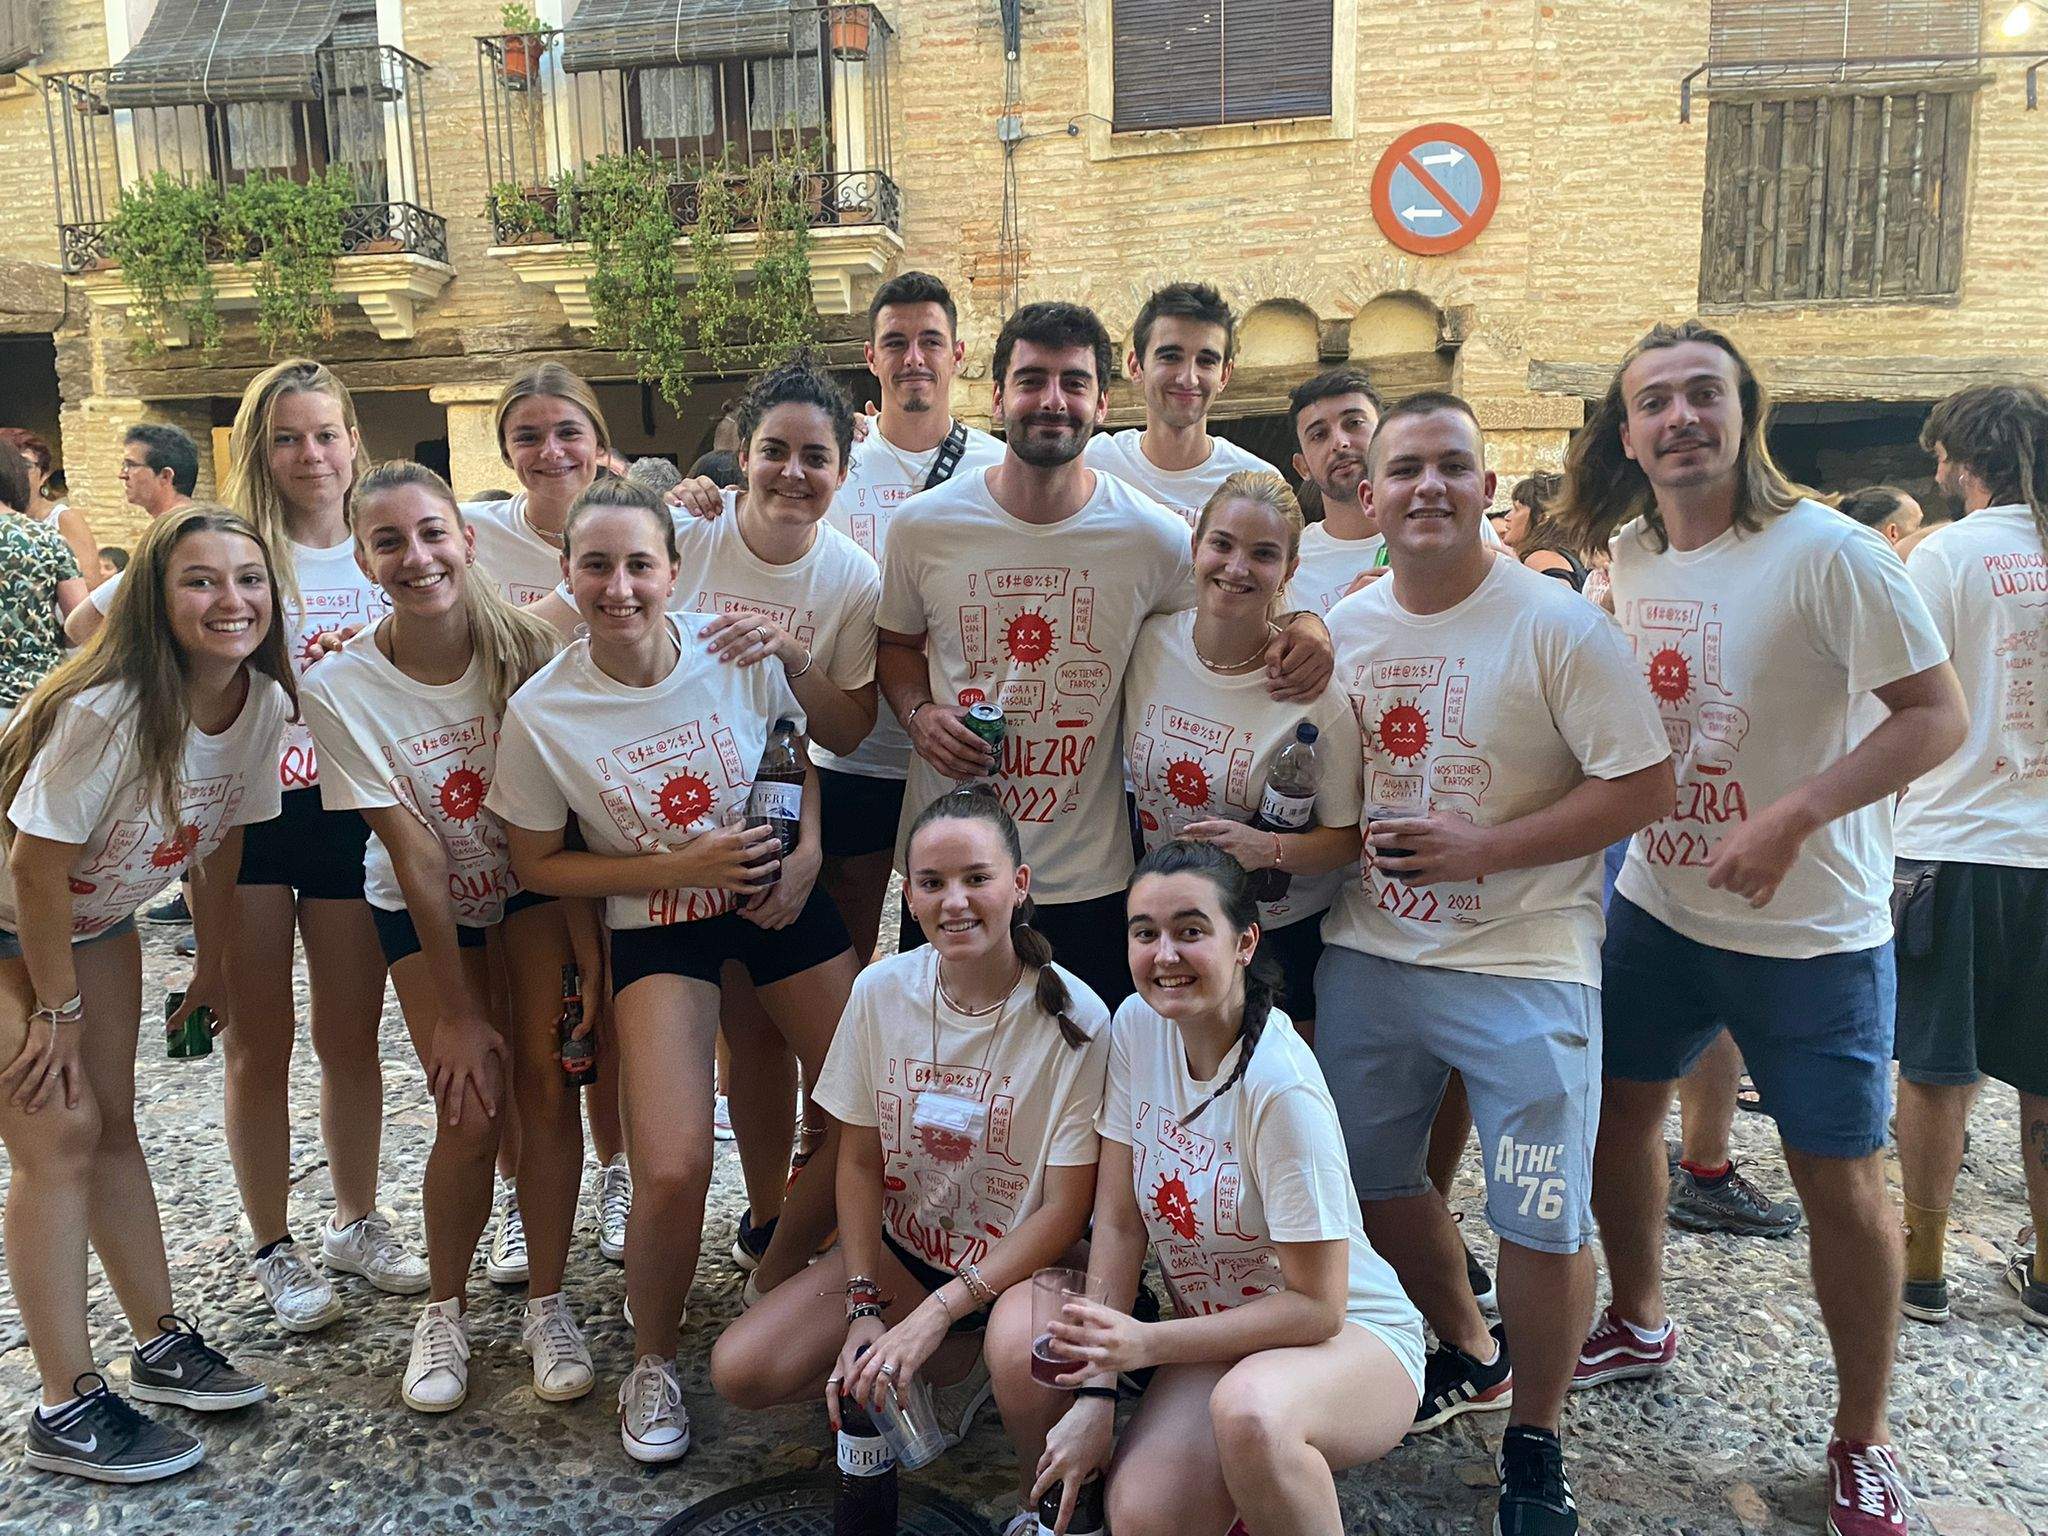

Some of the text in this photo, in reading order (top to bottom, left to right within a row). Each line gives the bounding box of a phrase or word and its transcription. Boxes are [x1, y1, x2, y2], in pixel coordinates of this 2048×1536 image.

[1434, 764, 1481, 775] NOS TIENES
[1448, 894, 1482, 910] 2021
[1517, 1175, 1567, 1220] 76
